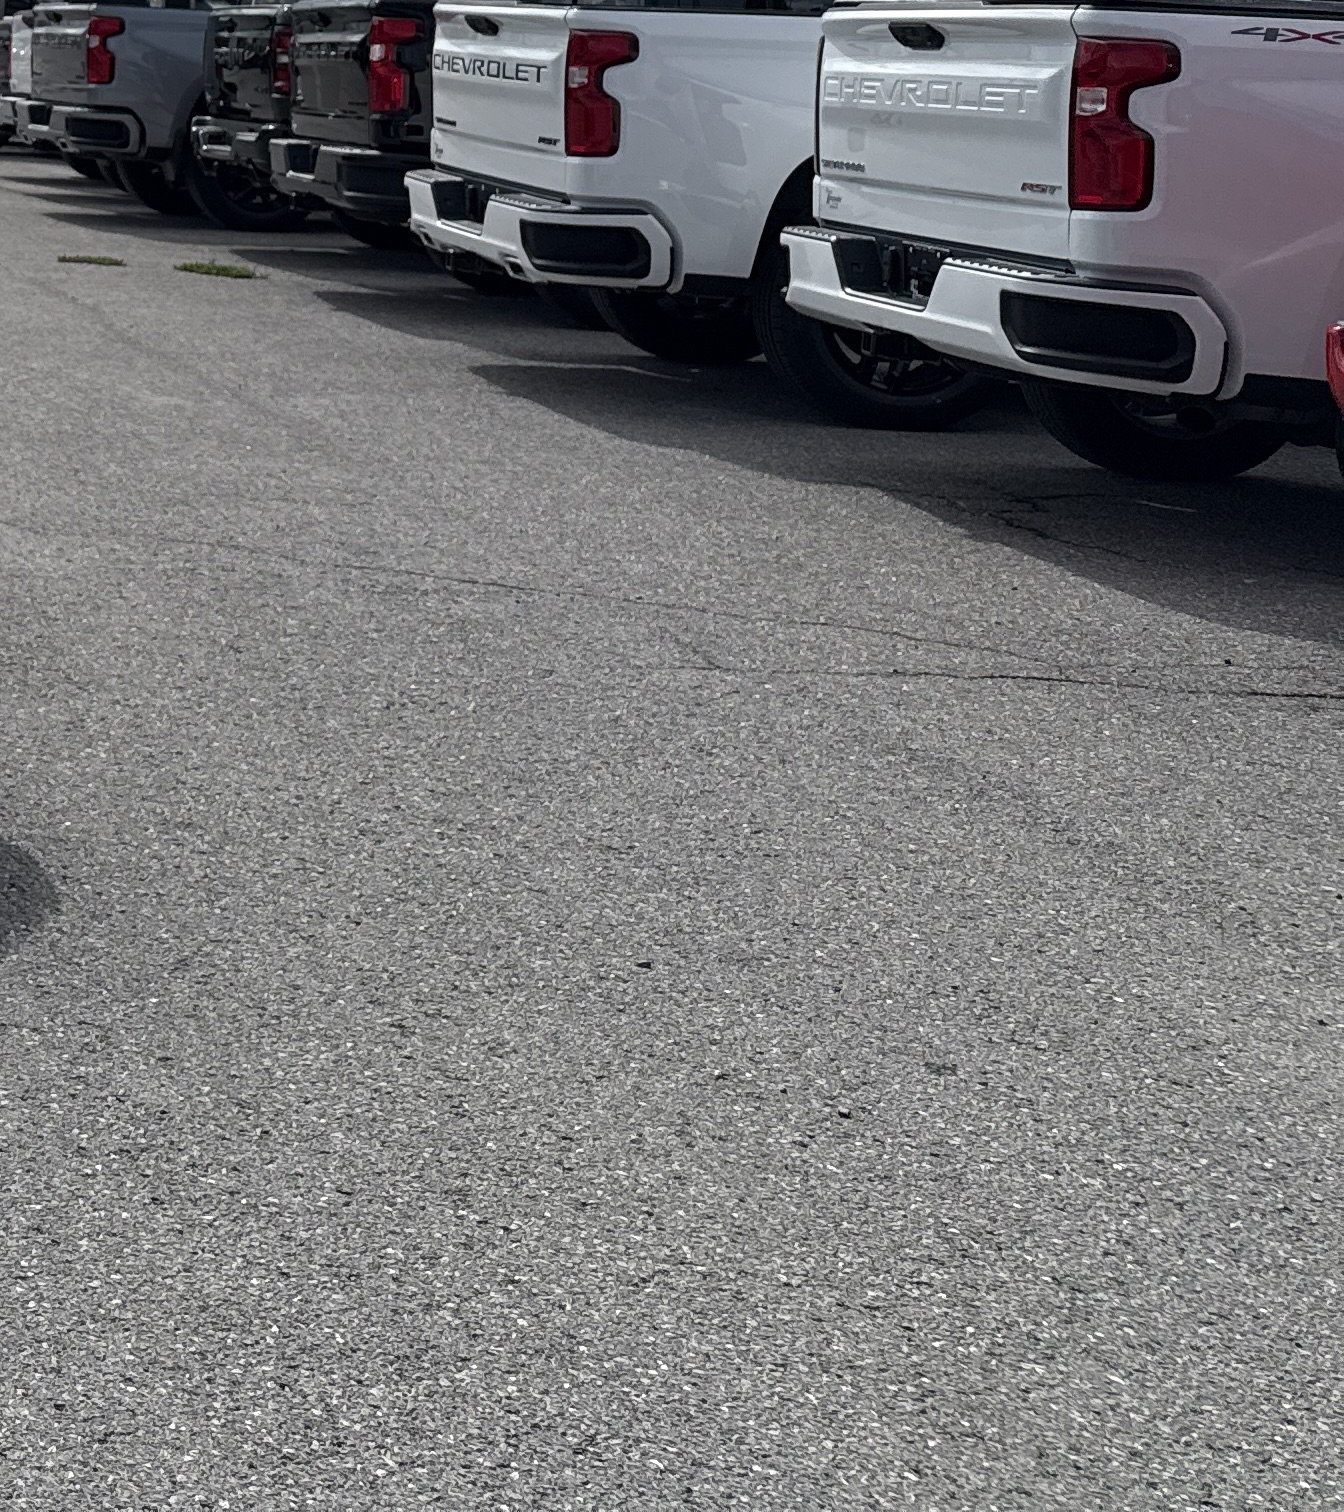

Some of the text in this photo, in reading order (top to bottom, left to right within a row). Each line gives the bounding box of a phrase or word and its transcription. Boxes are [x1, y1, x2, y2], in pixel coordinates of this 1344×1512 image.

[433, 53, 547, 83] CHEVROLET
[823, 76, 1039, 113] CHEVROLET
[1020, 182, 1063, 196] RST
